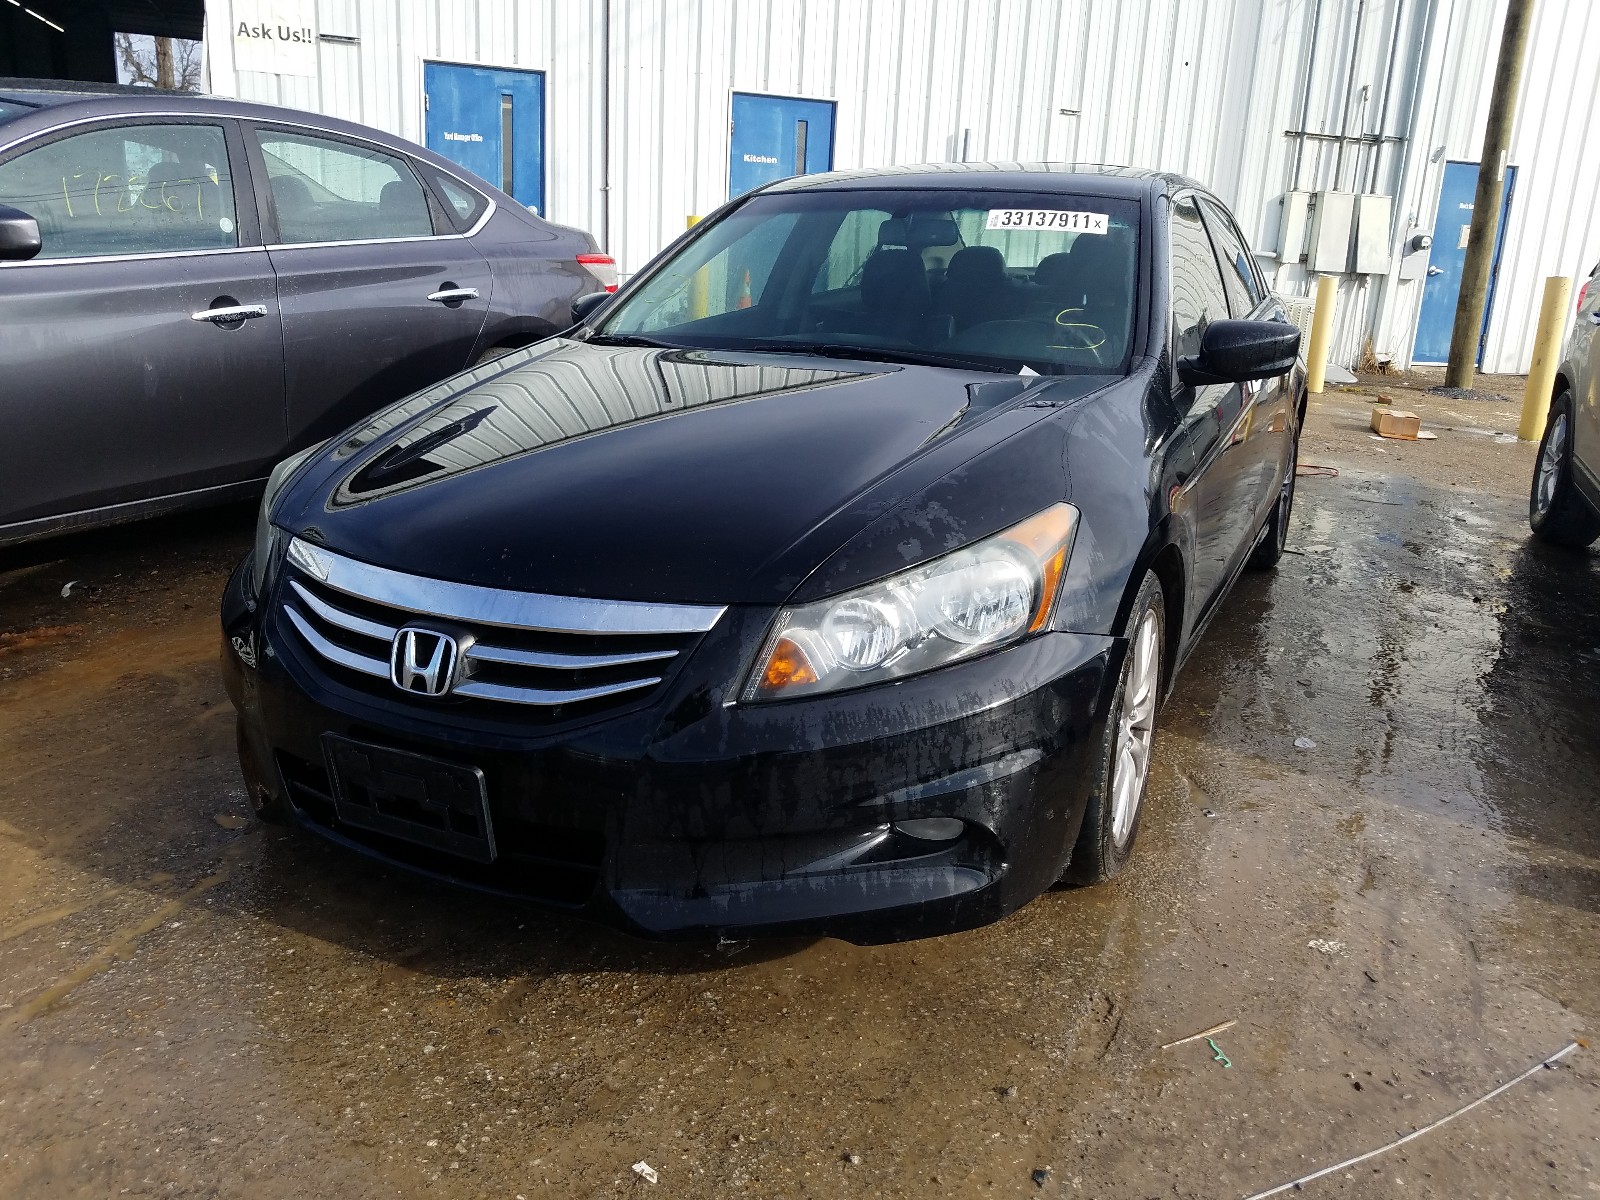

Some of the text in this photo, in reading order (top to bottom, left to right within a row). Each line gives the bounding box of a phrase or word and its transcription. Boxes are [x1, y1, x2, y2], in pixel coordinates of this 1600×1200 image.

[237, 21, 312, 44] Ask Us!!
[743, 154, 778, 164] Kitchen
[1001, 211, 1091, 229] 33137911
